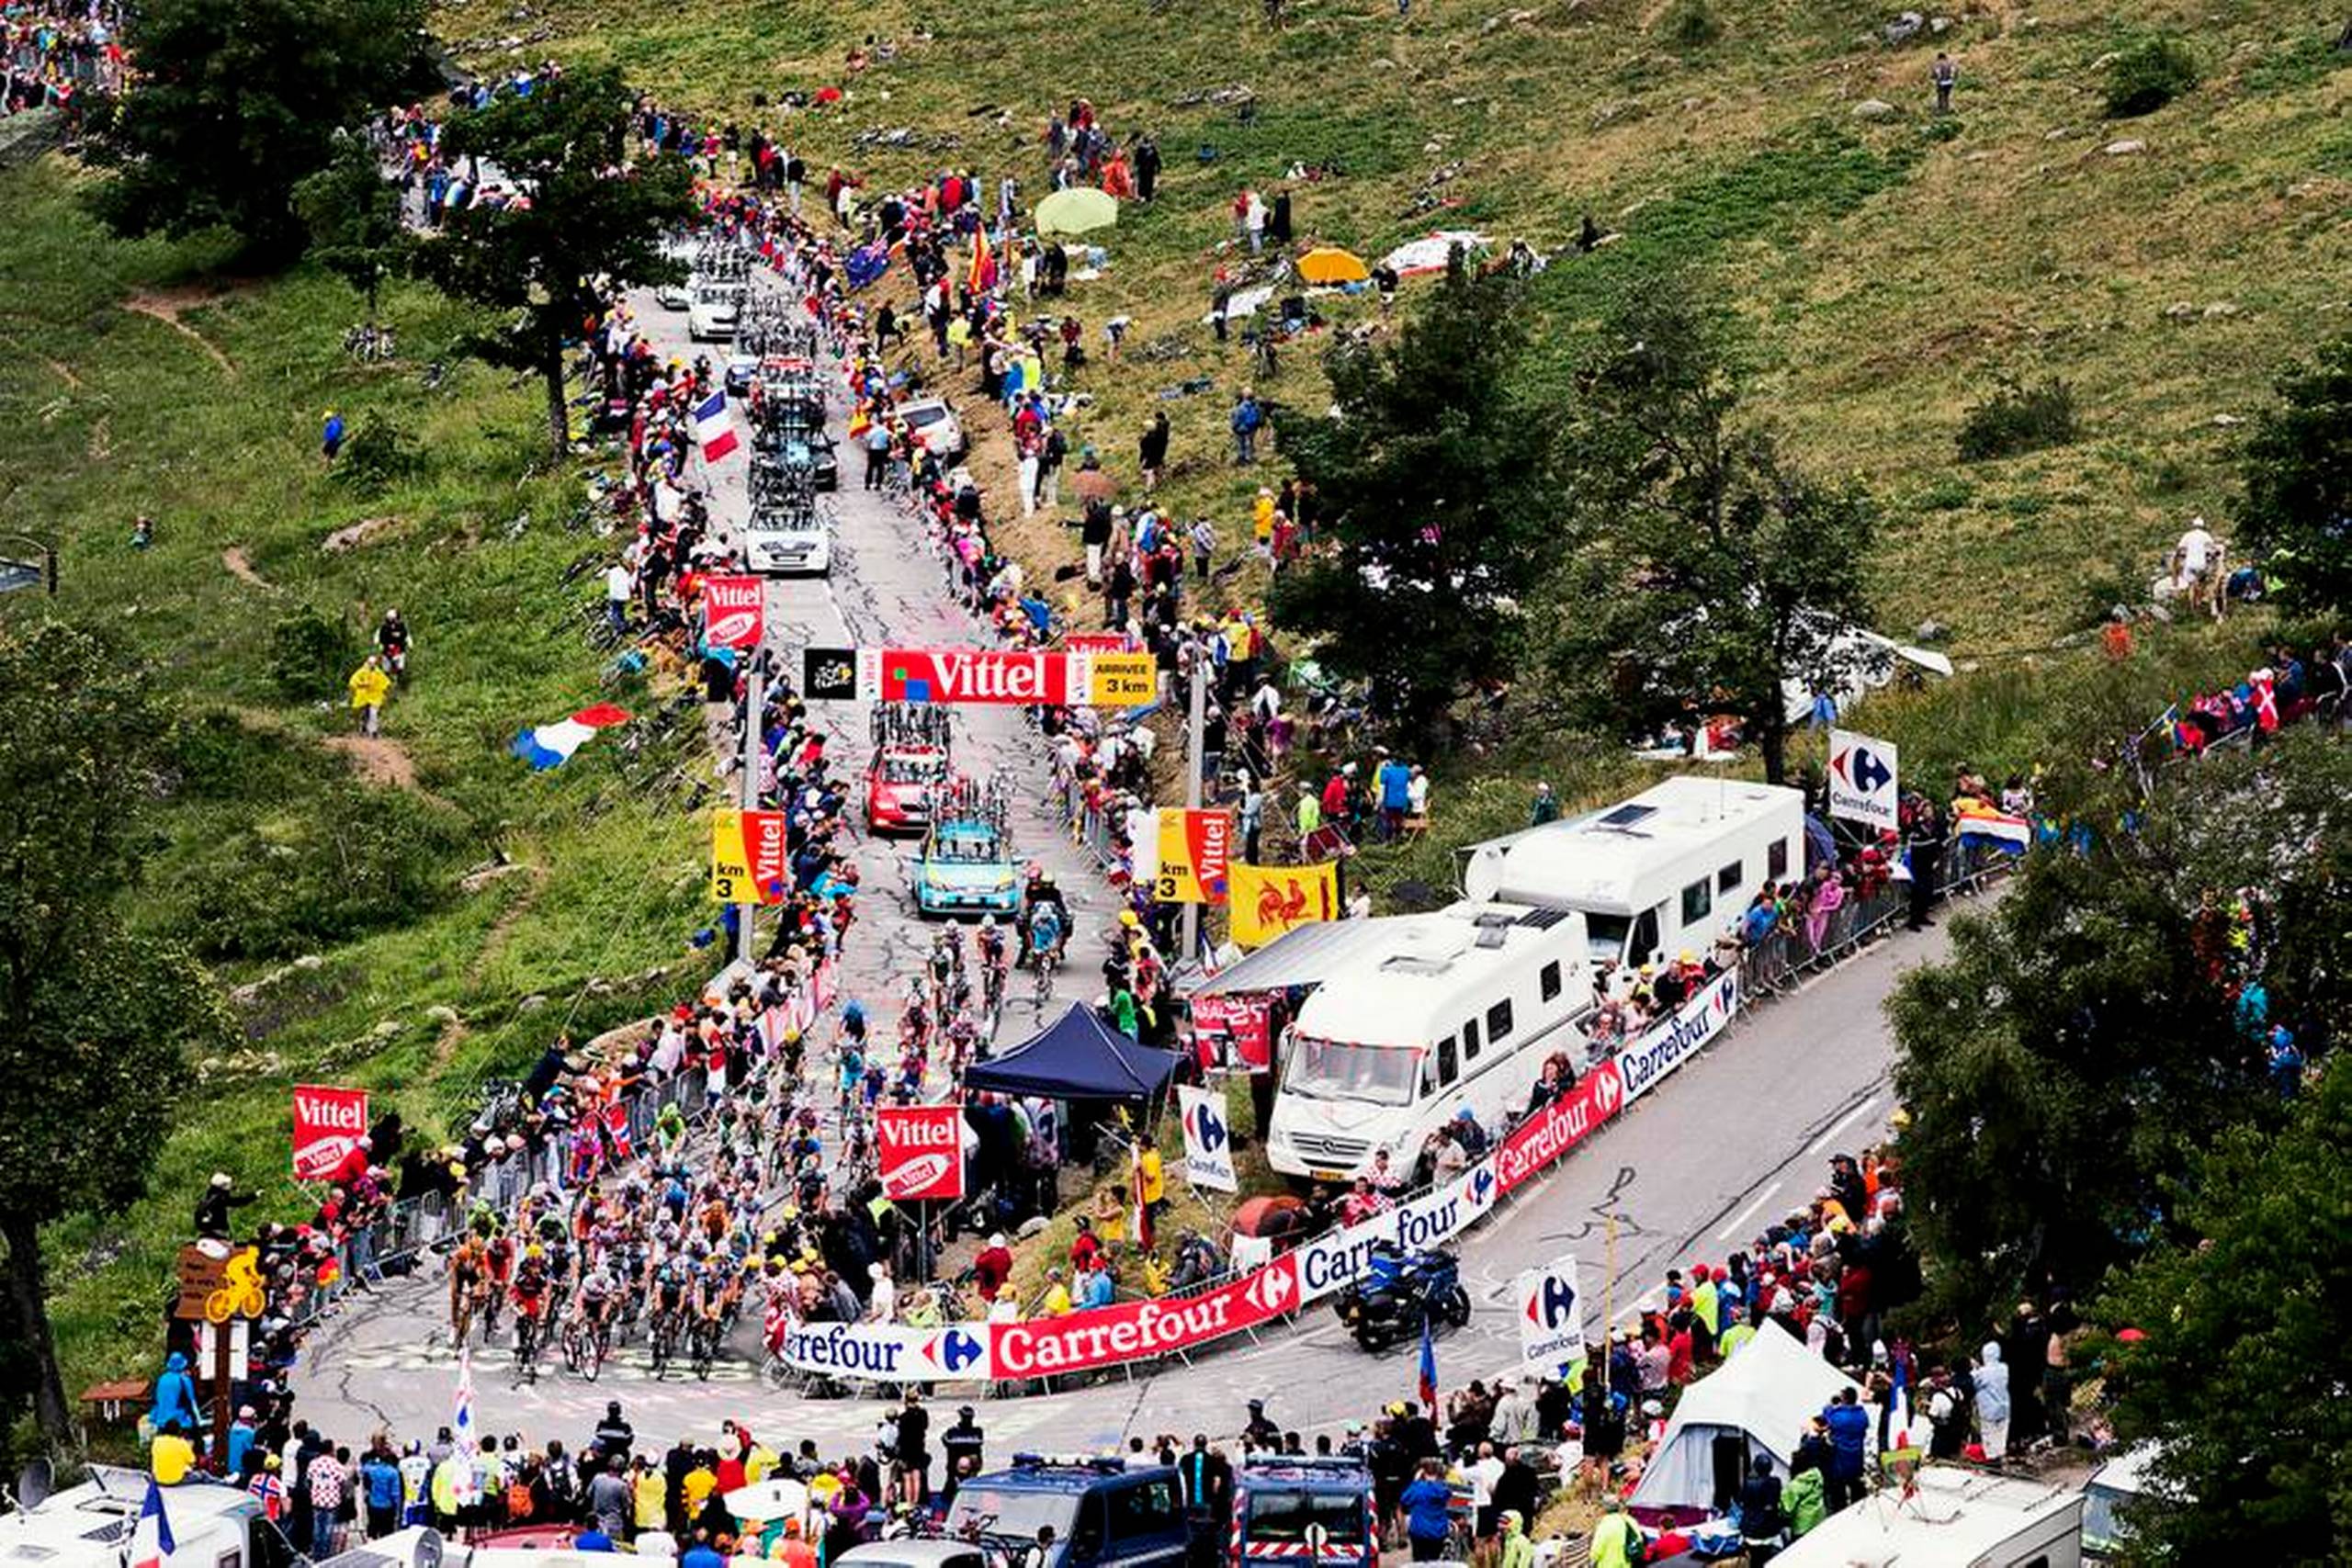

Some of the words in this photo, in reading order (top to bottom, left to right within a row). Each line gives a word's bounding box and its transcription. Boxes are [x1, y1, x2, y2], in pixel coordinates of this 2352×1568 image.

[710, 584, 761, 606] Vittel
[930, 653, 1046, 698] Vittel
[1106, 679, 1119, 693] 3
[1122, 679, 1148, 693] km
[718, 863, 744, 876] km
[757, 819, 781, 883] Vittel
[1161, 862, 1188, 875] km
[1200, 818, 1226, 882] Vittel
[717, 879, 732, 897] 3
[1160, 878, 1176, 897] 3
[1623, 1005, 1709, 1092] Carrefour
[296, 1096, 361, 1130] Vittel
[880, 1116, 956, 1147] Vittel
[1498, 1098, 1589, 1185] Carrefour
[1306, 1197, 1458, 1290] Carrfour
[792, 1325, 904, 1372] refour
[1000, 1293, 1231, 1371] Carrefour
